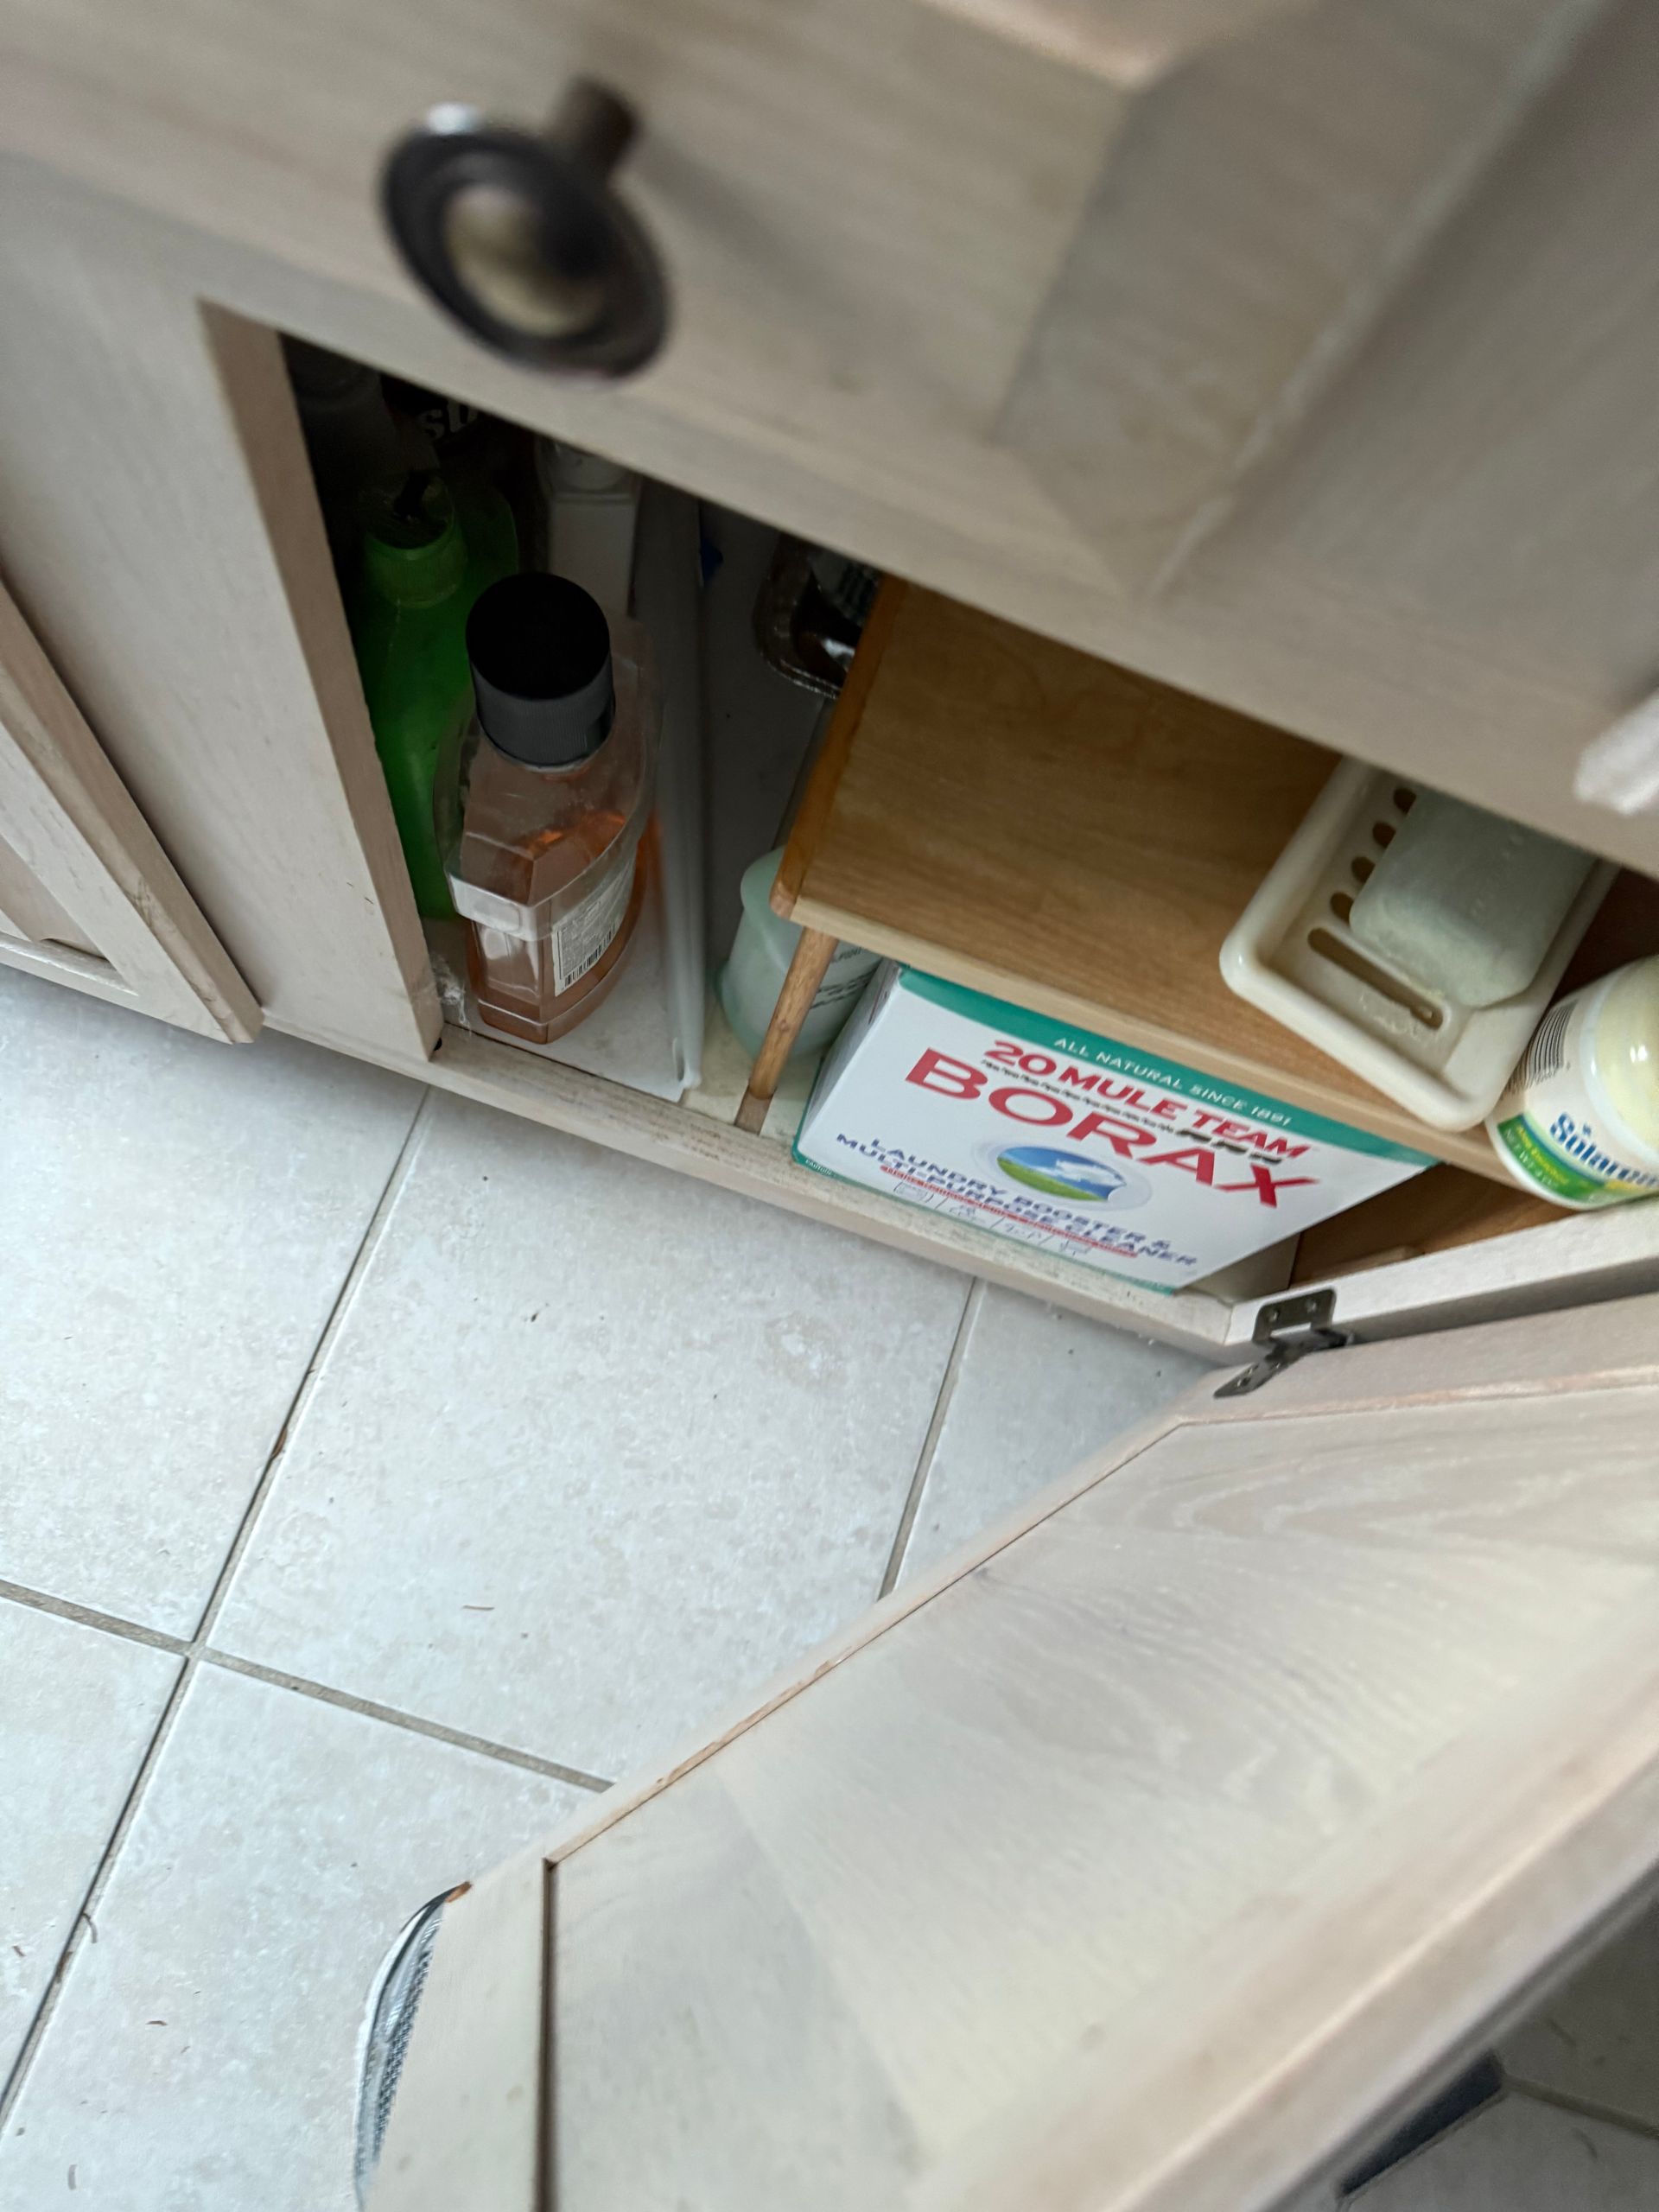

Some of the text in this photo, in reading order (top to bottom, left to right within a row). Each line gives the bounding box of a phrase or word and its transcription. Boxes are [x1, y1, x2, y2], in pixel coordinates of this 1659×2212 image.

[905, 1047, 1320, 1208] BORAX
[983, 1040, 1312, 1159] 20 MULE TEAM
[1054, 1038, 1293, 1126] ALL NATURAL SINCE 1891
[836, 1133, 1056, 1224] MULTI-PURPOSE
[1064, 1224, 1198, 1266] CLEANER
[871, 1138, 1007, 1195] LAUNDRY
[1014, 1196, 1147, 1243] BOOSTER
